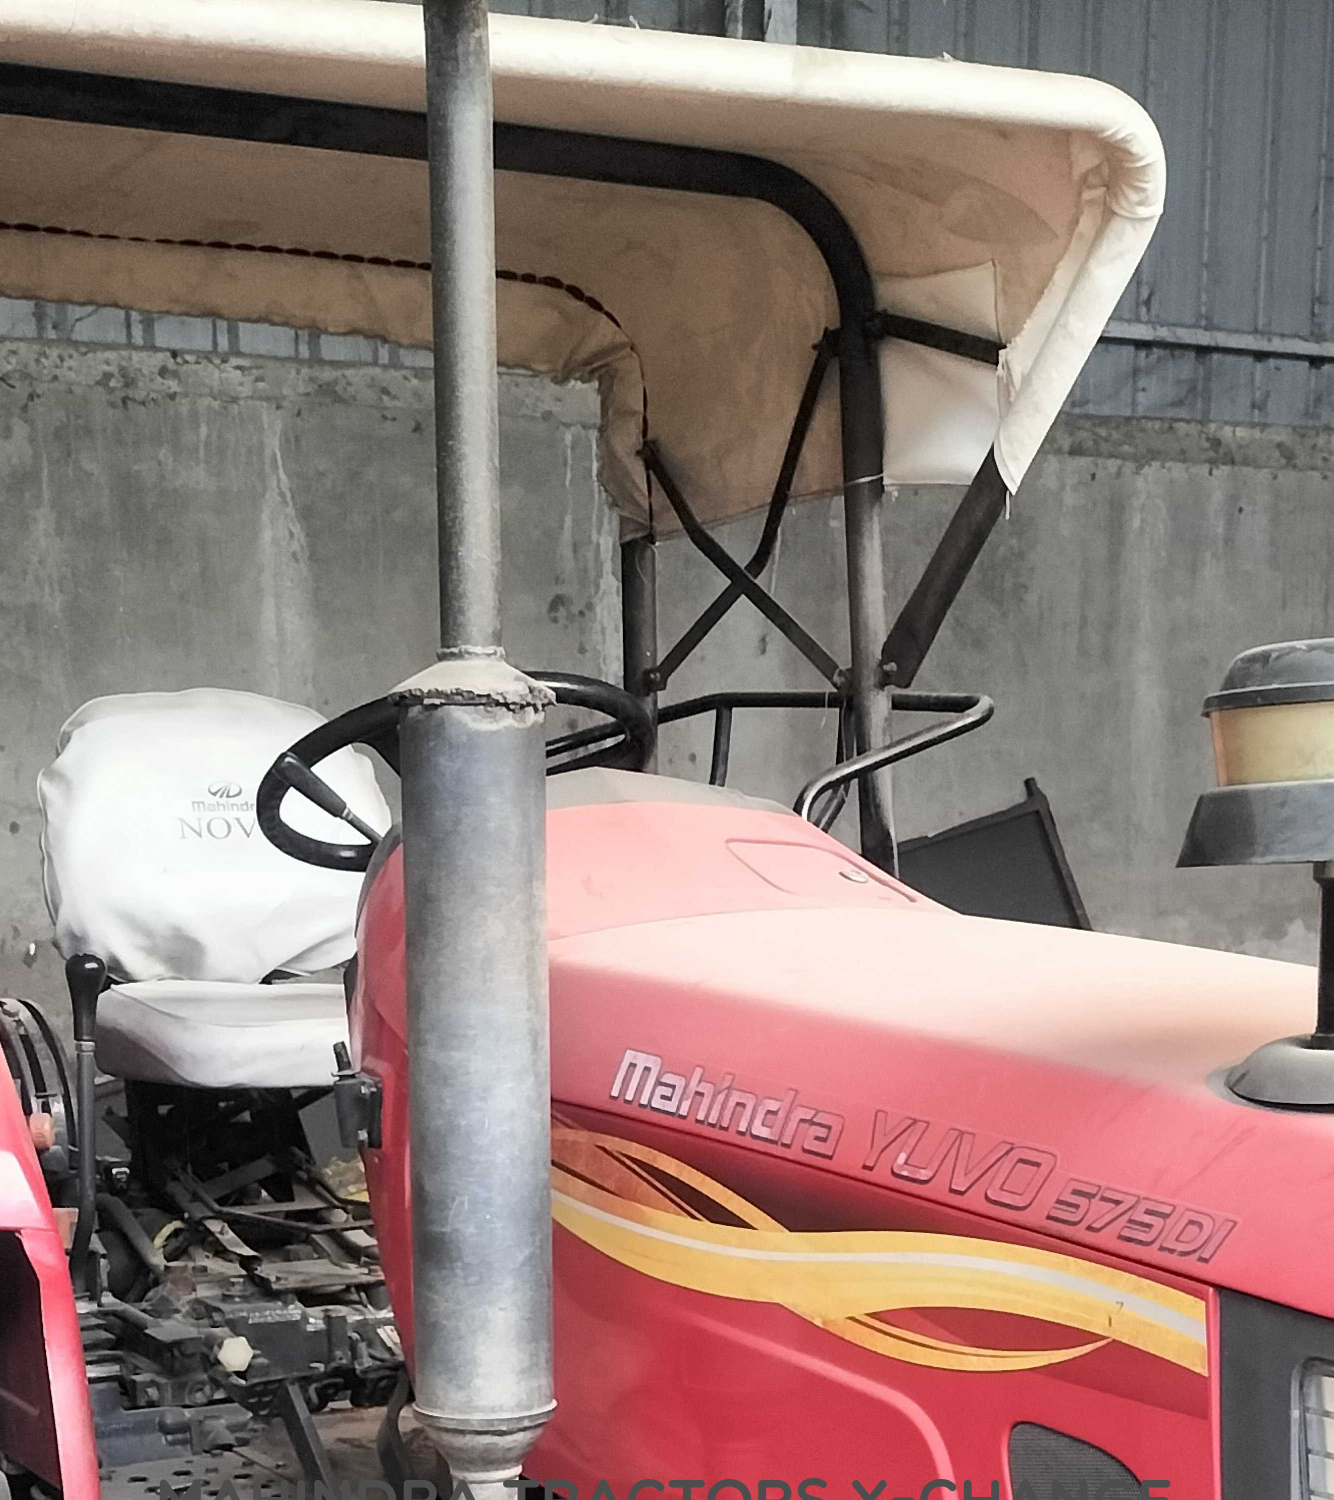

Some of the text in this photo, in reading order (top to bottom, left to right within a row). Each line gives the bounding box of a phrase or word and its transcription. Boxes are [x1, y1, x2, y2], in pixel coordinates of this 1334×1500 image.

[191, 800, 255, 812] Mahindr
[176, 816, 256, 840] NOV
[610, 1048, 1238, 1264] Mahindra YUVO 575DI
